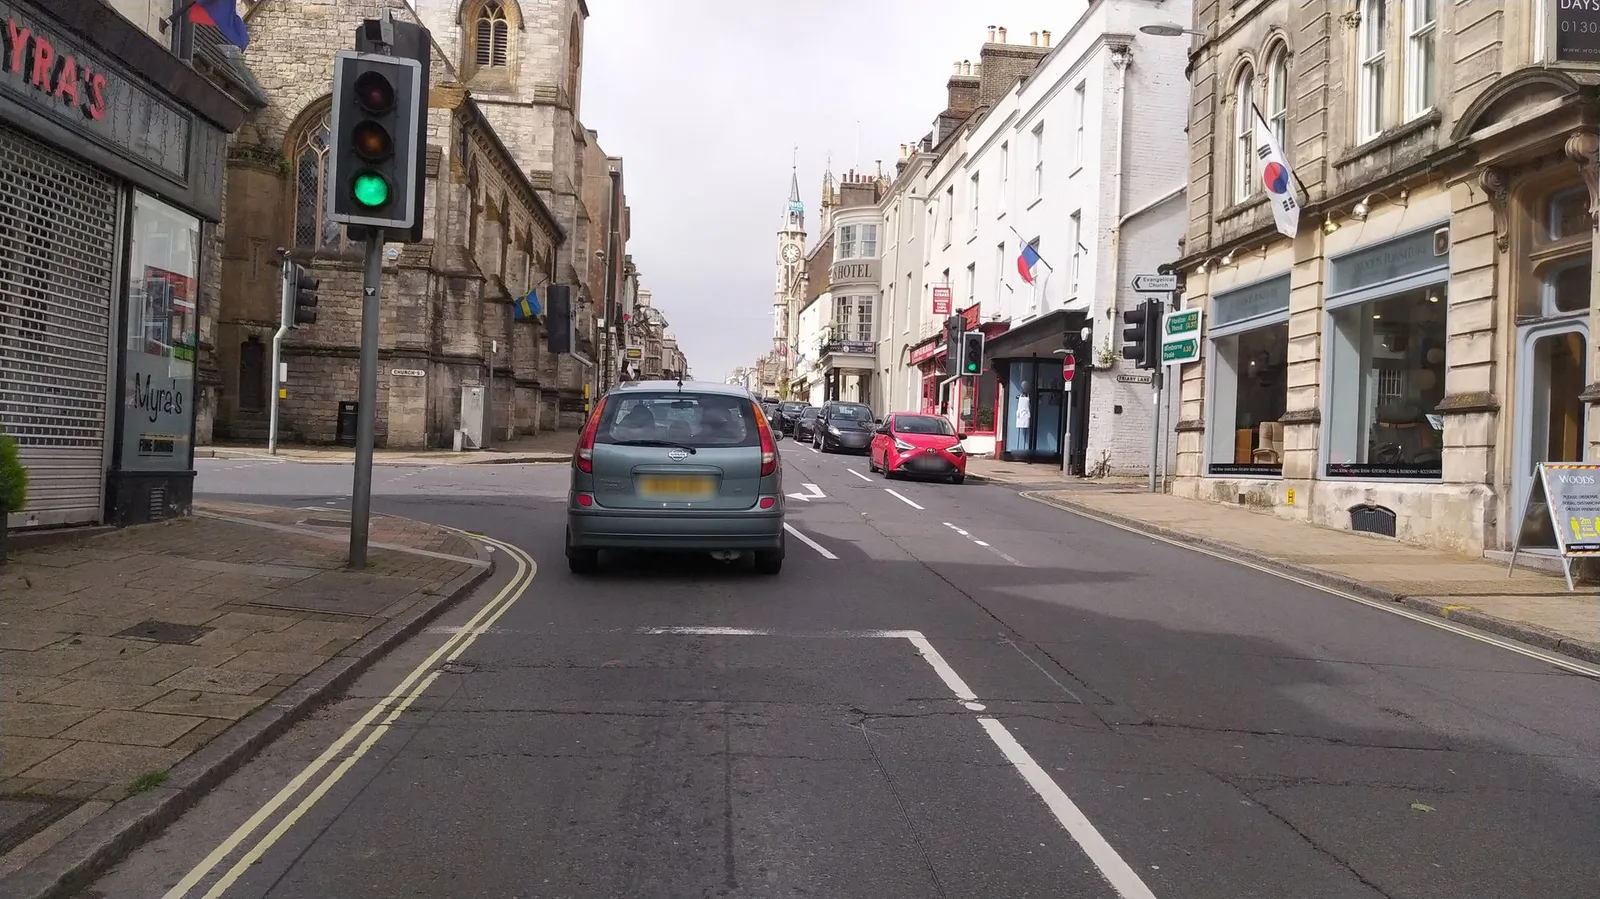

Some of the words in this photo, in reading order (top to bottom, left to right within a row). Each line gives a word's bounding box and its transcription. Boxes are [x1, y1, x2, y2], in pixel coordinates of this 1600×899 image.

[1561, 20, 1600, 33] 0130
[837, 264, 872, 279] HOTEL
[134, 372, 183, 423] Myra's
[1559, 475, 1595, 484] WOODS
[1580, 517, 1592, 525] 2m
